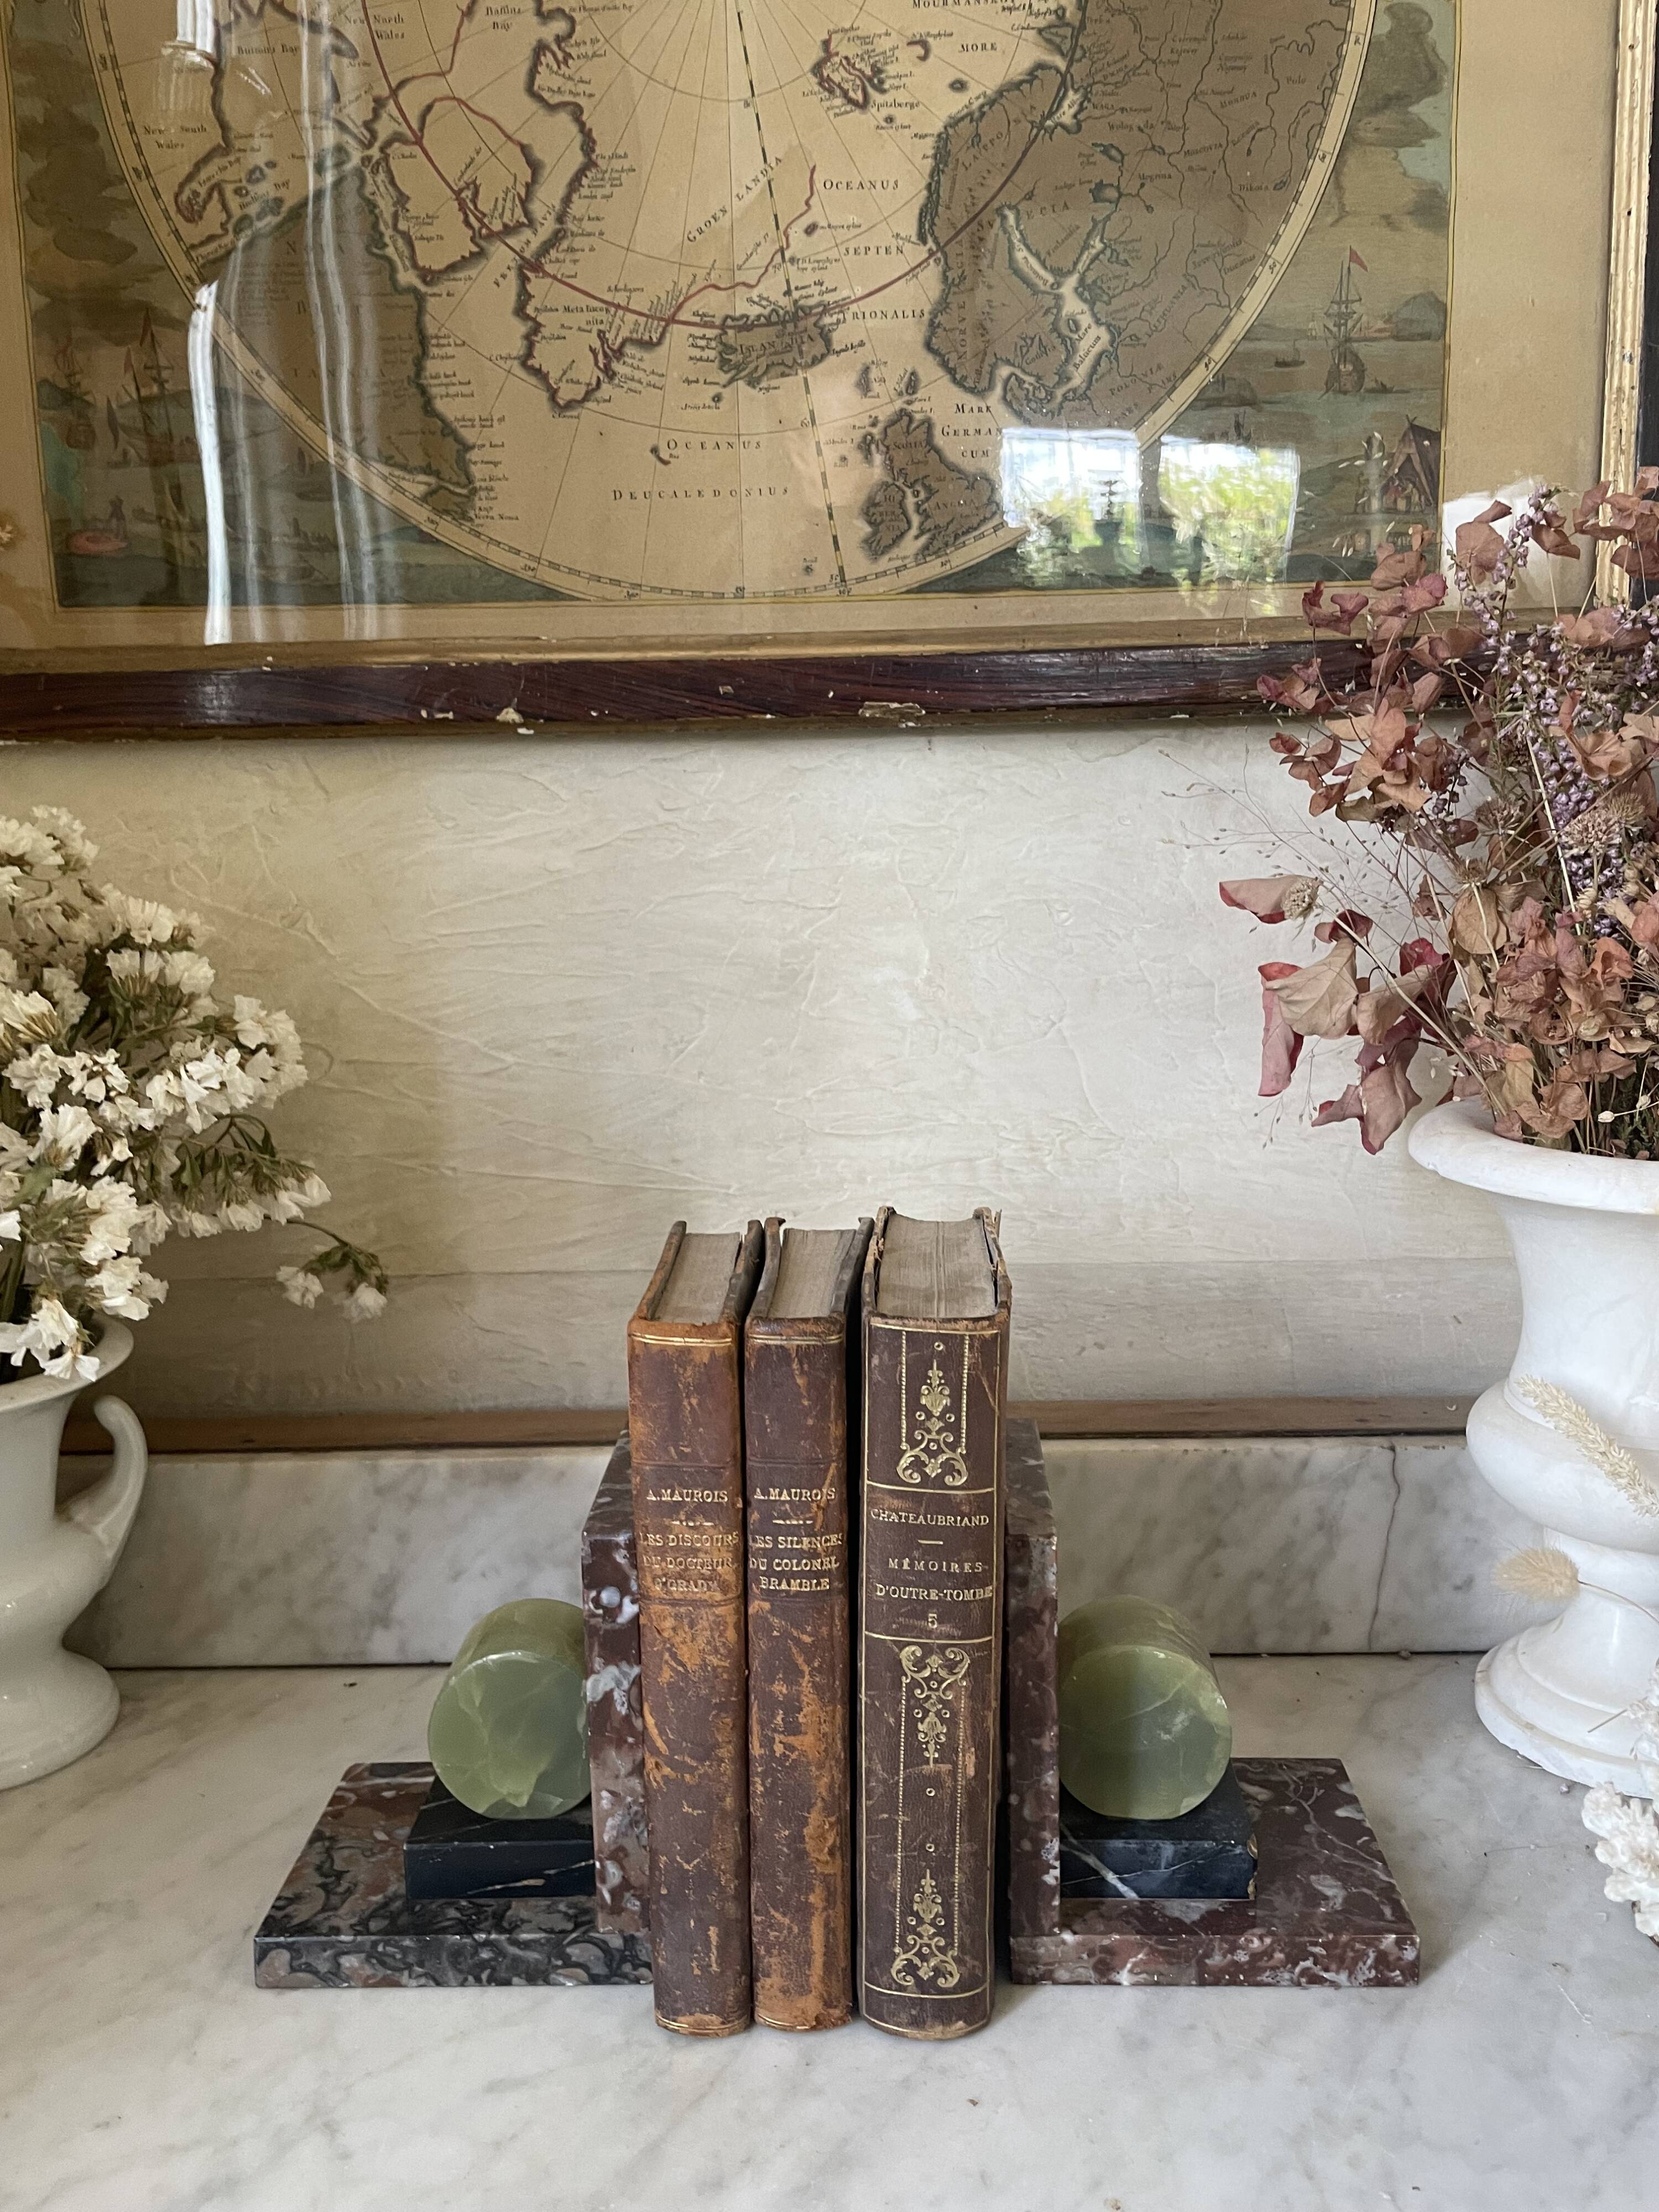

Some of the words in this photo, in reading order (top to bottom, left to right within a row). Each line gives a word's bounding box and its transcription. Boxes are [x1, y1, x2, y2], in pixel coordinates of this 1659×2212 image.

[958, 42, 997, 53] MORE
[823, 179, 899, 191] OCEANUS
[843, 246, 905, 256] SEPTEN
[667, 438, 761, 451] OCEANUS
[961, 450, 990, 458] CUM
[612, 487, 788, 501] DEUCALEDONIUS
[870, 1509, 990, 1527] CHATEAUBRIAND
[667, 1531, 739, 1547] DISCOURS
[749, 1557, 768, 1571] DU
[759, 1575, 830, 1592] BRAMBLE
[875, 1583, 994, 1601] D'OUTRE-TOMBE
[927, 1613, 938, 1629] 5
